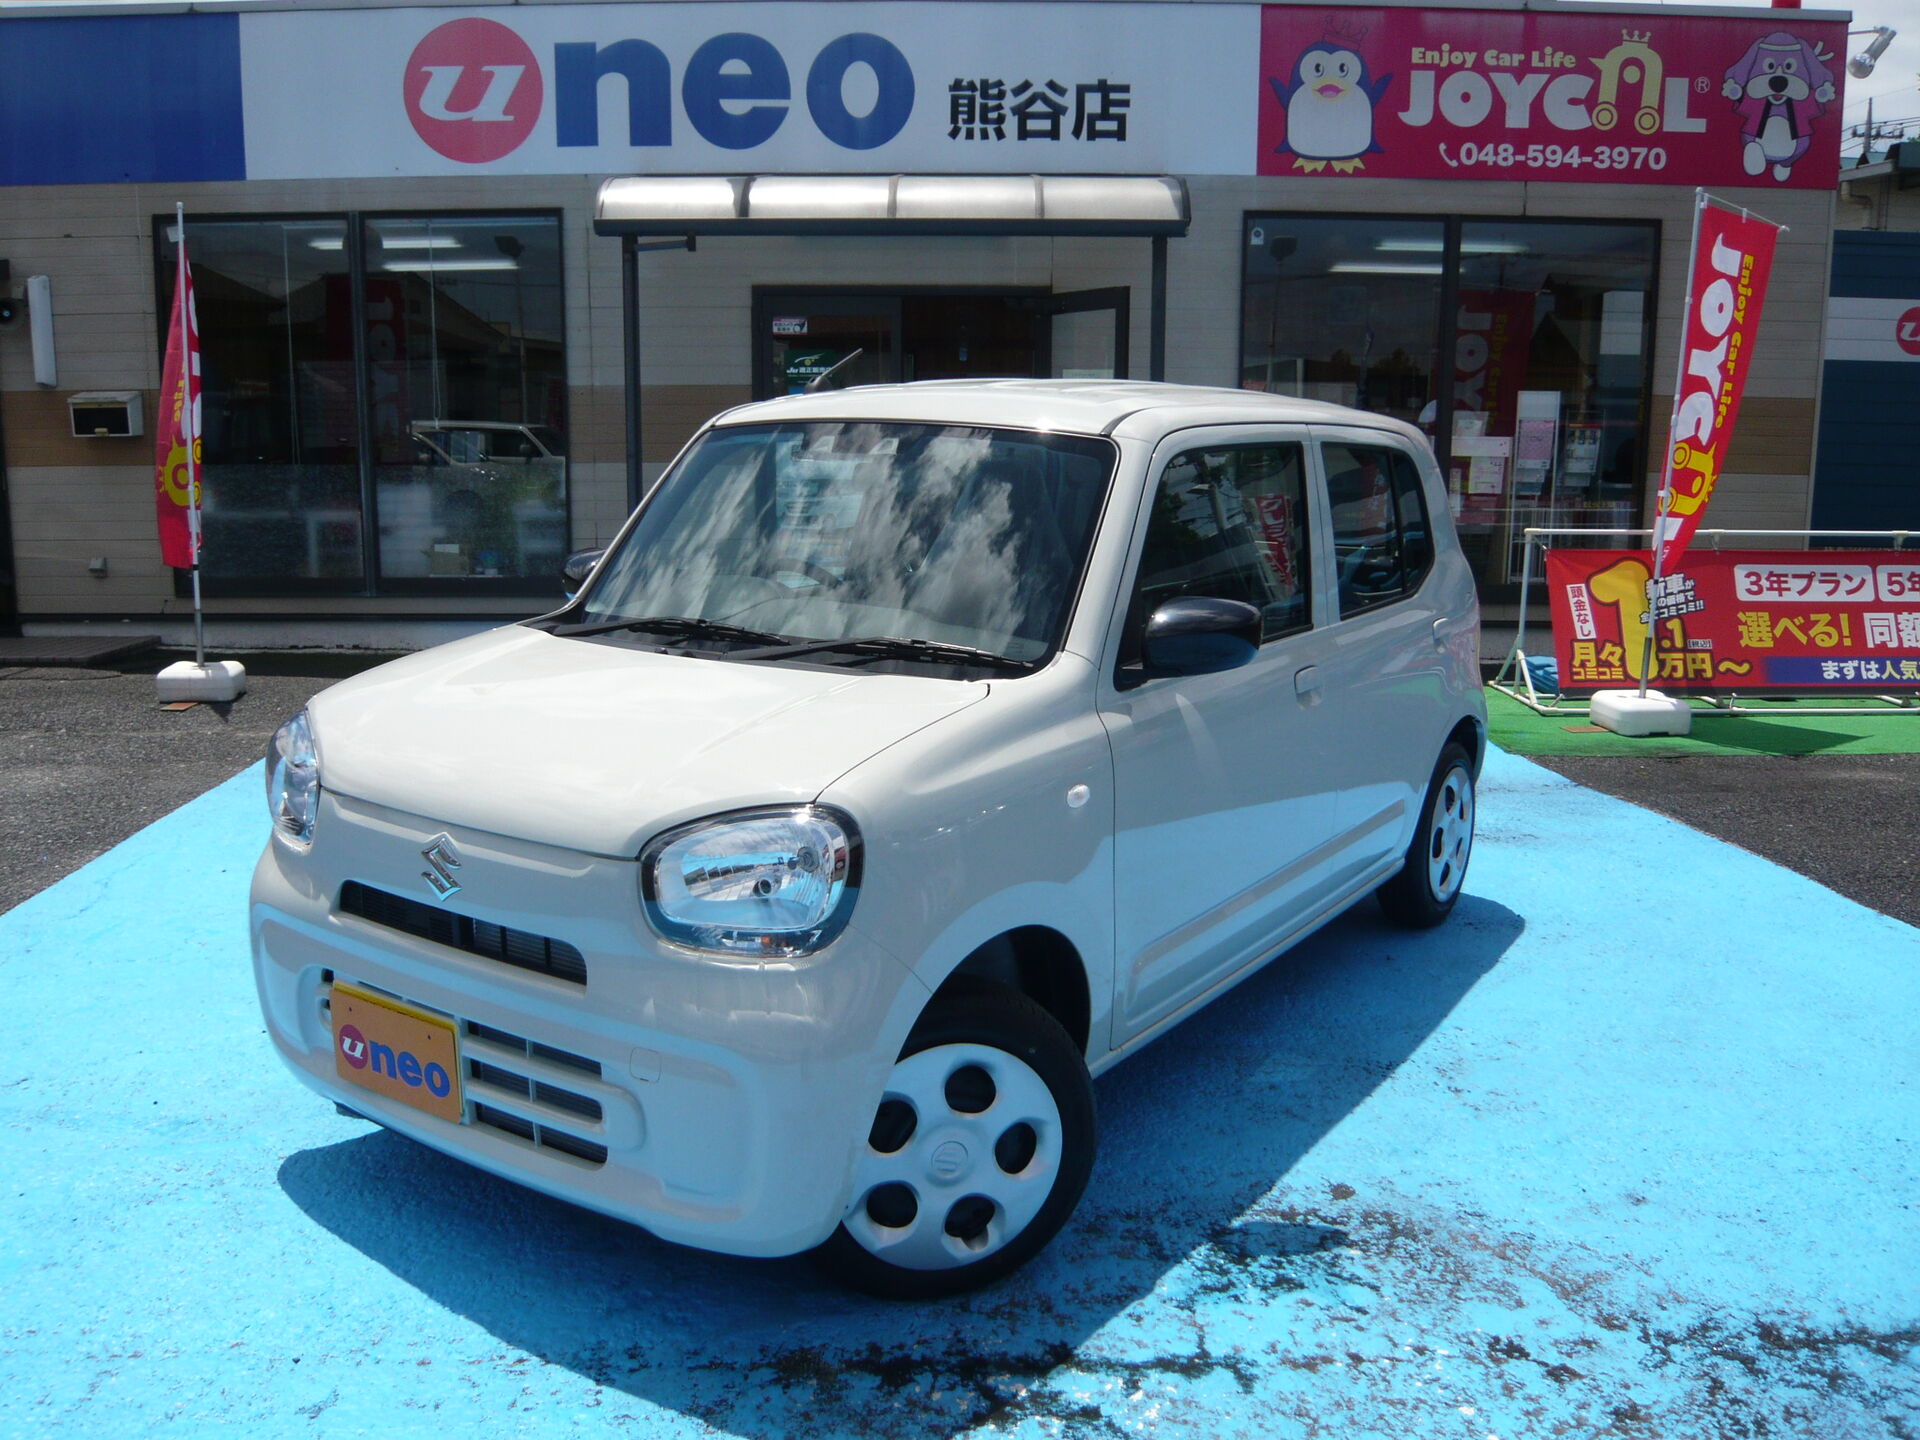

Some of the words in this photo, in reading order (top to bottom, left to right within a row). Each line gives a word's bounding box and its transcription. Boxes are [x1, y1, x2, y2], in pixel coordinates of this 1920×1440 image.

[1410, 43, 1477, 68] Enjoy
[1484, 49, 1525, 67] Car
[1531, 46, 1576, 68] Life
[419, 32, 916, 150] uneo
[947, 78, 1131, 142] 熊谷店
[1459, 141, 1668, 170] 048-594-3970
[1733, 254, 1754, 325] Enjoy
[1726, 331, 1742, 376] Car
[1715, 381, 1733, 429] Life
[1743, 571, 1867, 597] 3年プラン
[1569, 585, 1592, 638] 頭金なし
[1572, 641, 1624, 668] 月々
[1572, 667, 1625, 680] コミコミ
[342, 1036, 450, 1098] uneo
